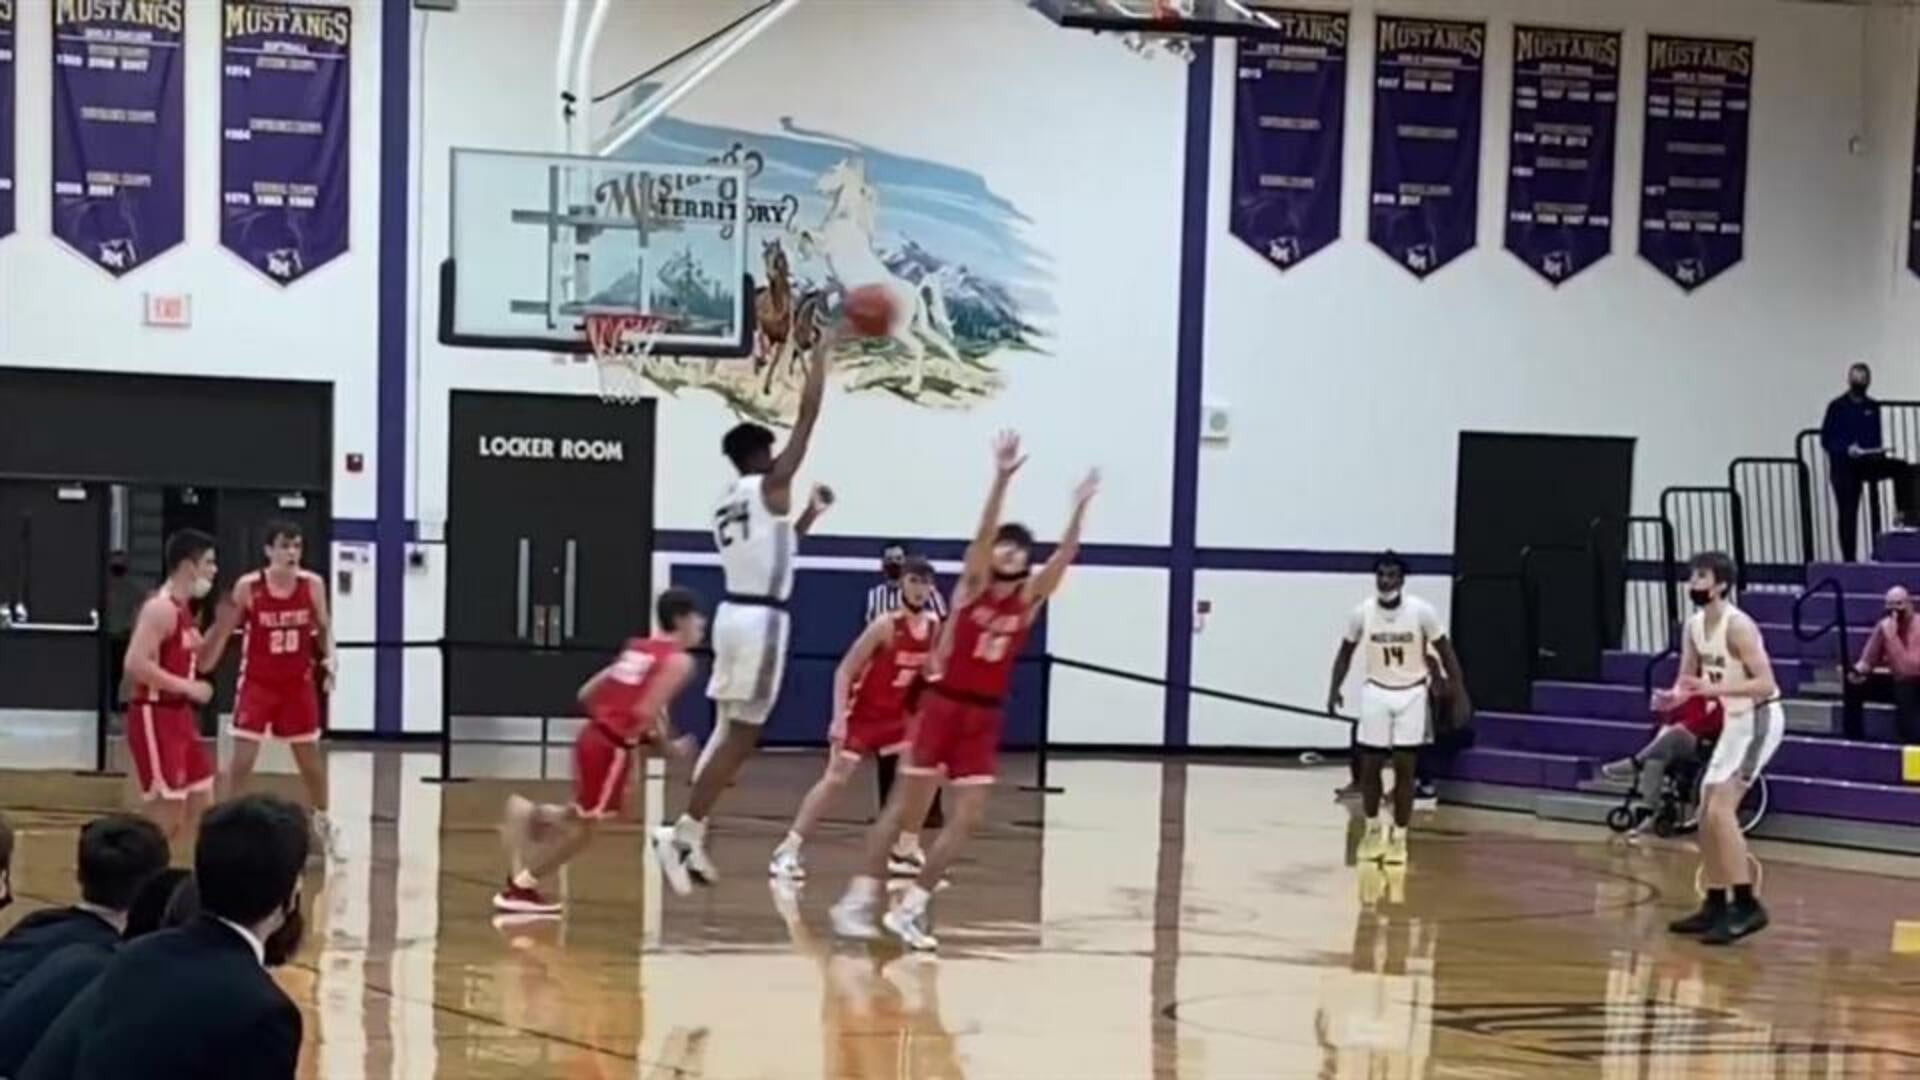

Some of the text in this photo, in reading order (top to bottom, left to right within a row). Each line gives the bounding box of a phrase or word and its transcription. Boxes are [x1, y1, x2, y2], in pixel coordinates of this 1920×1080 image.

[56, 0, 181, 32] MUSTANGS
[225, 4, 349, 45] MUSTANGS
[1380, 21, 1482, 58] MUSTANGS
[1517, 31, 1617, 67] MUSTANGS
[1651, 41, 1749, 76] MUSTANGS
[479, 435, 624, 461] LOCKER ROOM
[270, 629, 299, 653] 20
[1383, 646, 1404, 667] 14
